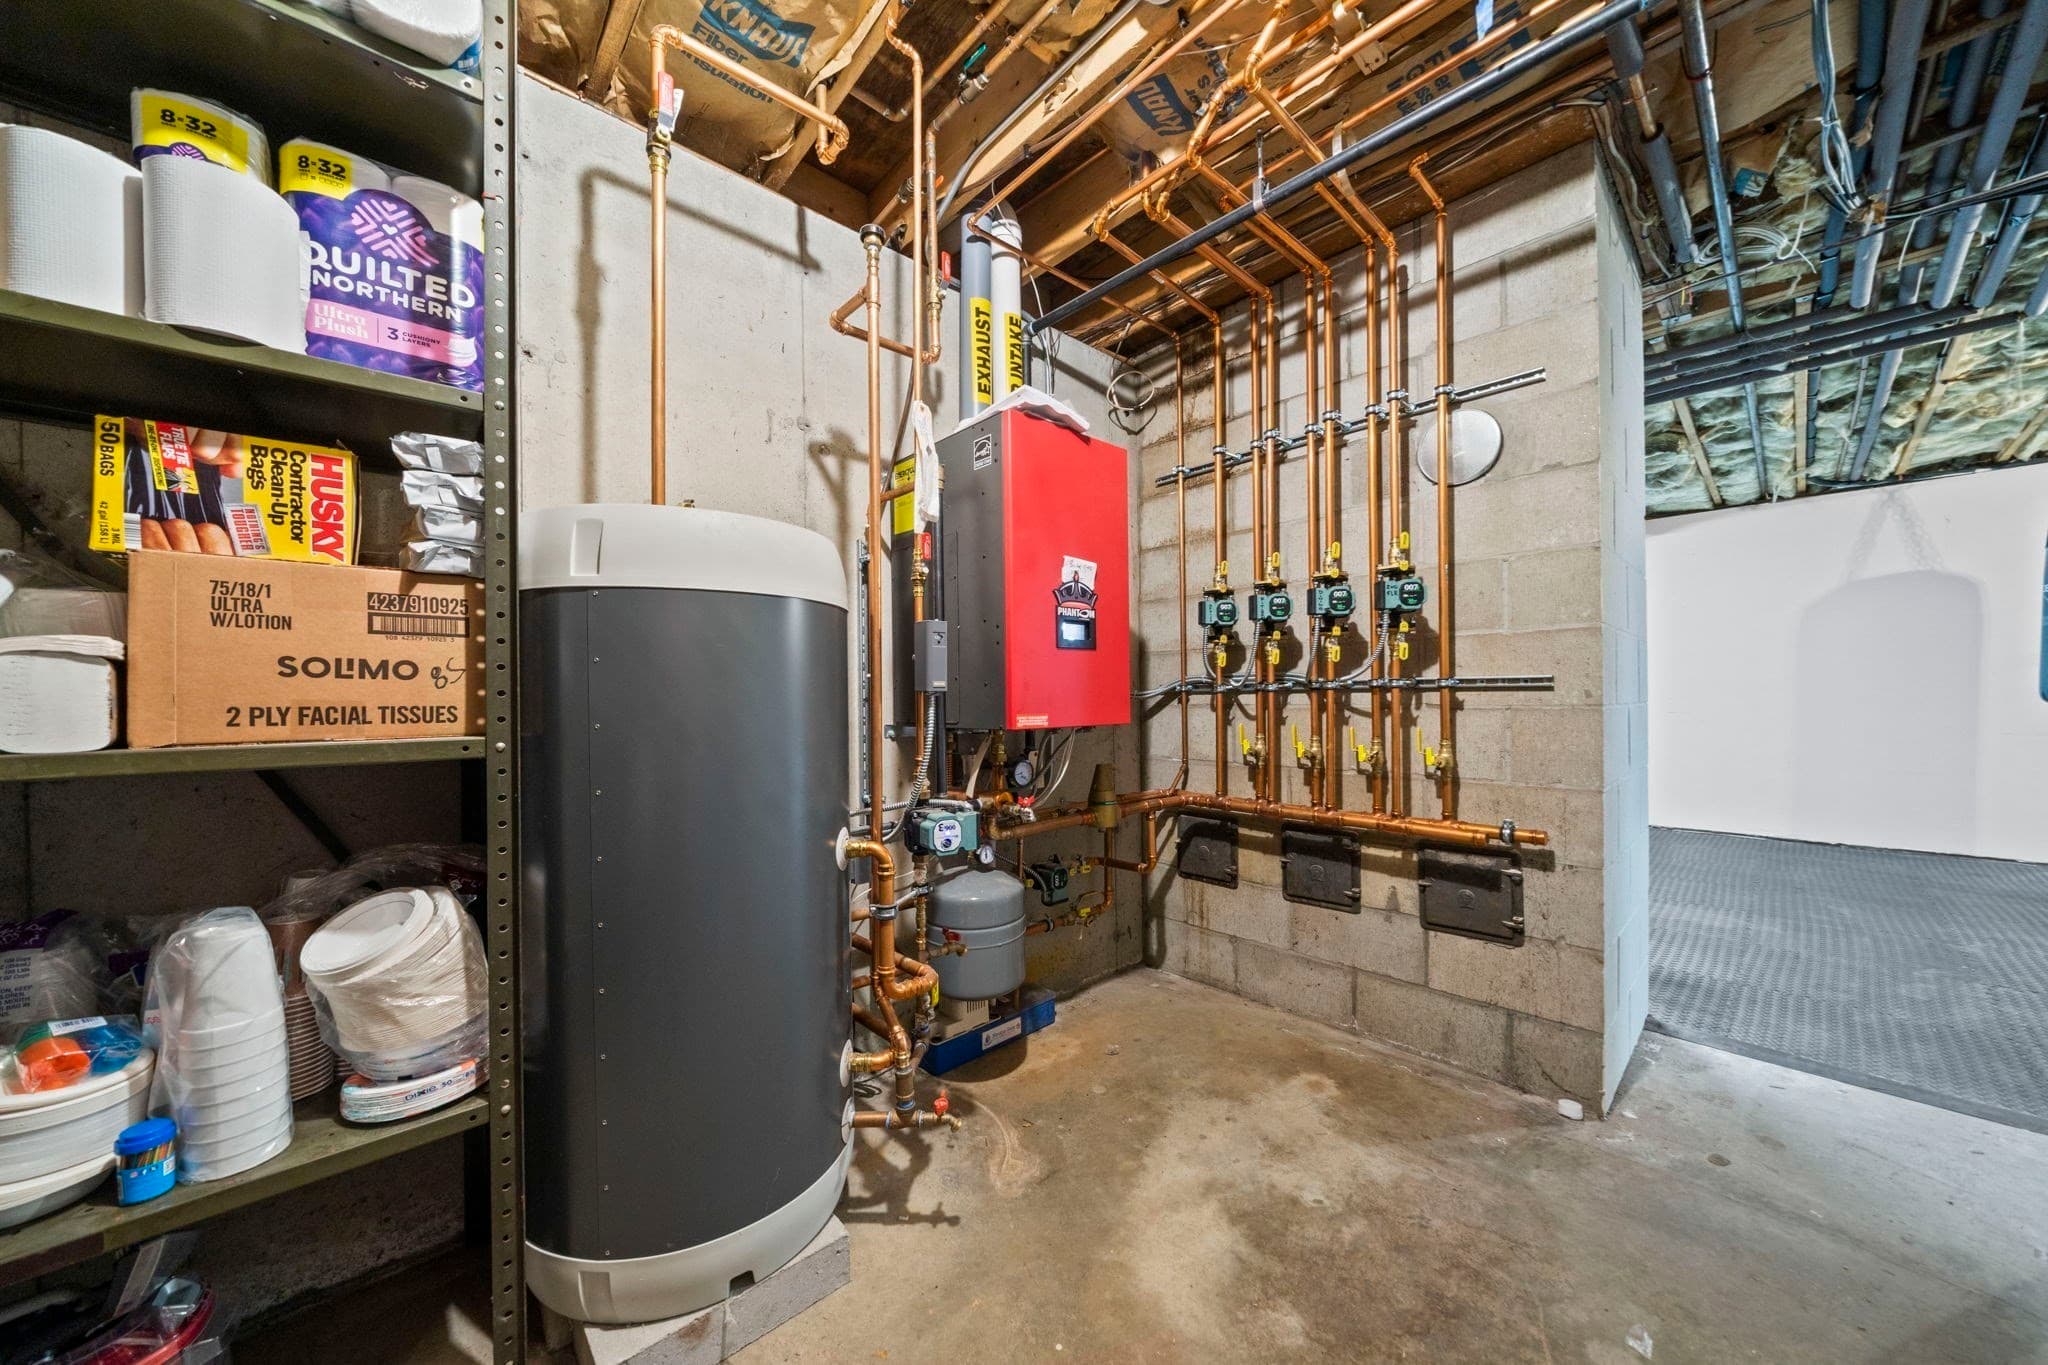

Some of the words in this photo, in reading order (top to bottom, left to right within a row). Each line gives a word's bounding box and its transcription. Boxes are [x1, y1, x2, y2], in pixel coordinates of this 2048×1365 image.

[691, 21, 748, 63] Fiber
[1134, 80, 1188, 135] KNAU
[309, 240, 476, 309] QUILTED
[312, 270, 464, 323] NORTHERN
[314, 303, 366, 326] Ultra
[314, 315, 369, 339] Plush
[387, 327, 399, 341] 3
[402, 331, 441, 345] CUSHIONY
[402, 337, 431, 348] LAYERS
[975, 306, 991, 396] EXHAUST
[1009, 315, 1022, 382] INTAKE
[100, 421, 120, 444] 50
[158, 431, 177, 460] FLAPS
[171, 427, 188, 450] TRUE
[100, 445, 115, 477] BAGS
[177, 449, 191, 467] TIE
[246, 444, 269, 490] Bags
[289, 450, 307, 544] Contractor
[310, 453, 345, 562] HUSKY
[230, 509, 255, 551] TOUGHER
[245, 508, 266, 551] NOTHING'S
[209, 579, 271, 599] 75/18/1
[211, 596, 263, 614] ULTRA
[1058, 606, 1095, 620] PHANTOM
[209, 612, 292, 631] W/LOTION
[277, 655, 419, 681] SOLIMO
[226, 706, 241, 728] 2
[249, 706, 291, 727] PLY
[298, 706, 373, 726] FACIAL
[378, 705, 458, 725] TISSUES
